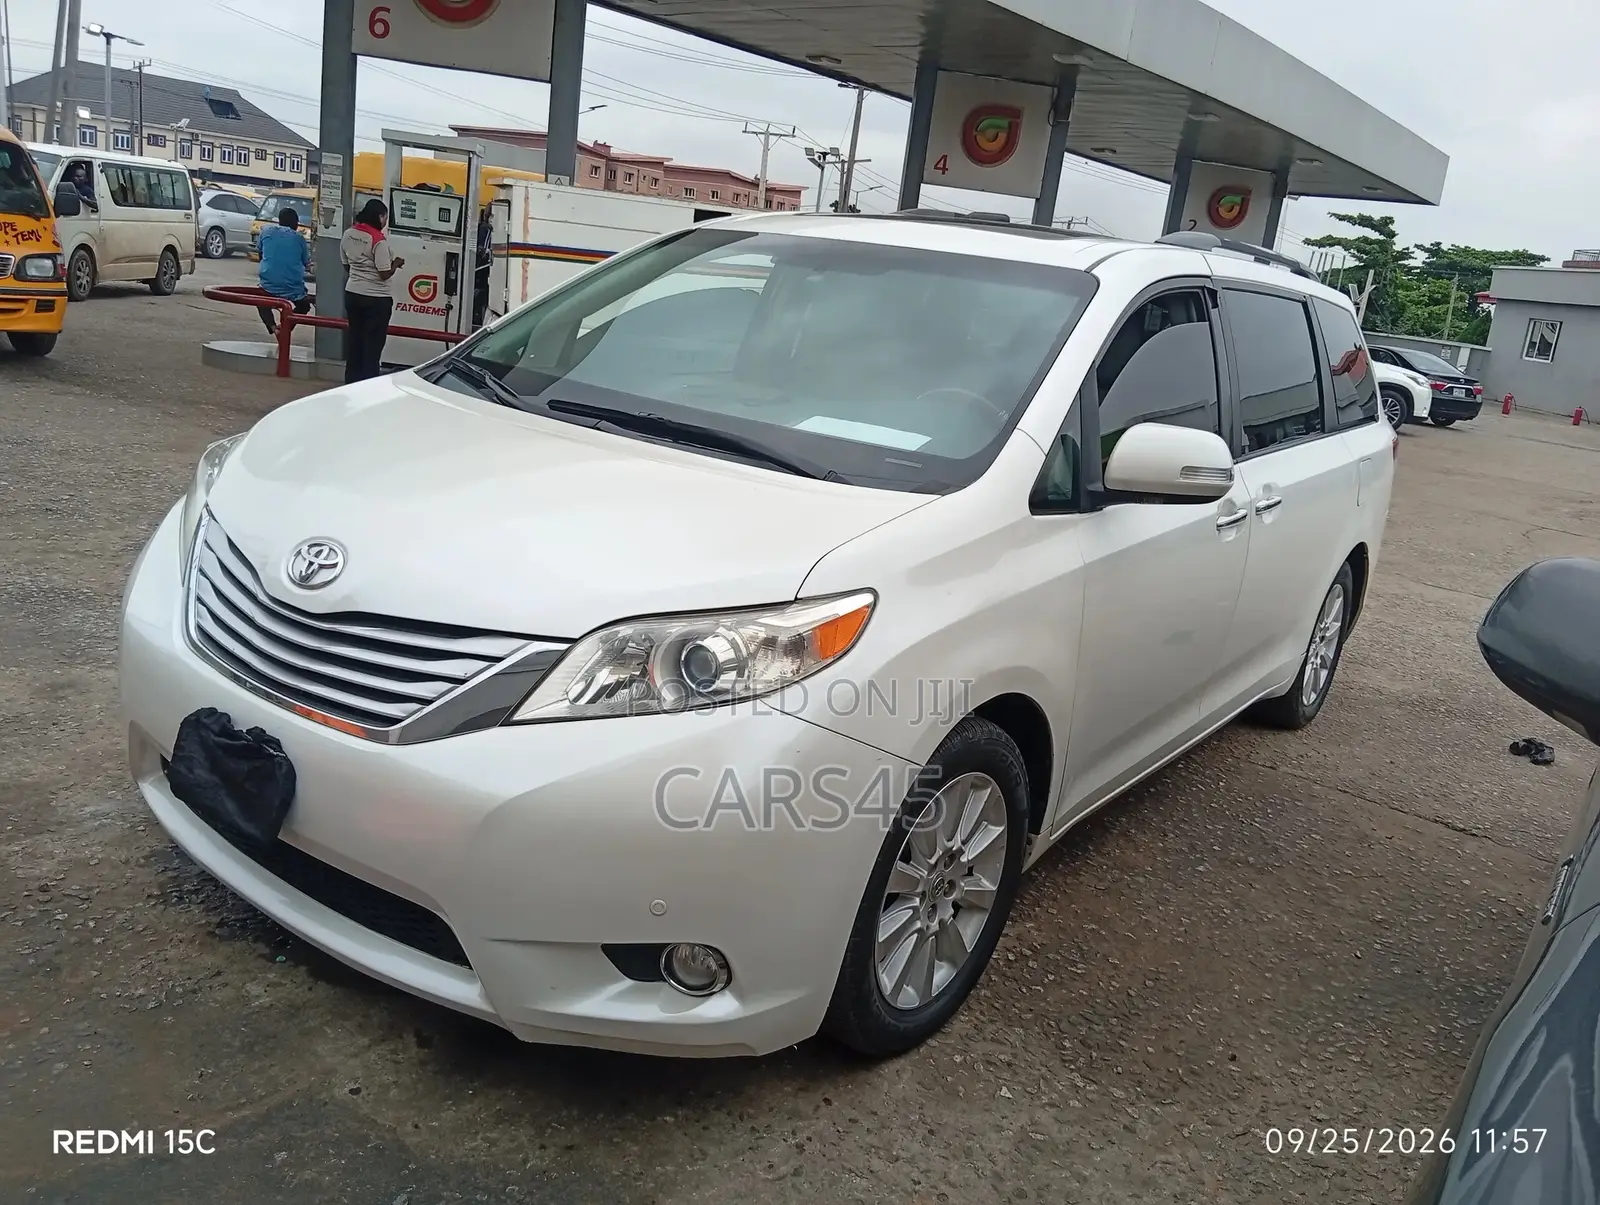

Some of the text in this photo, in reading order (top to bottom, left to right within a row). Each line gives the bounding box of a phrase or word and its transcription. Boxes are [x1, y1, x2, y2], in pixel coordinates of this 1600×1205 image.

[368, 5, 391, 39] 6
[933, 154, 948, 175] 4
[1188, 218, 1198, 231] 2
[12, 229, 42, 245] TEMI
[395, 302, 447, 317] FATGBEMS
